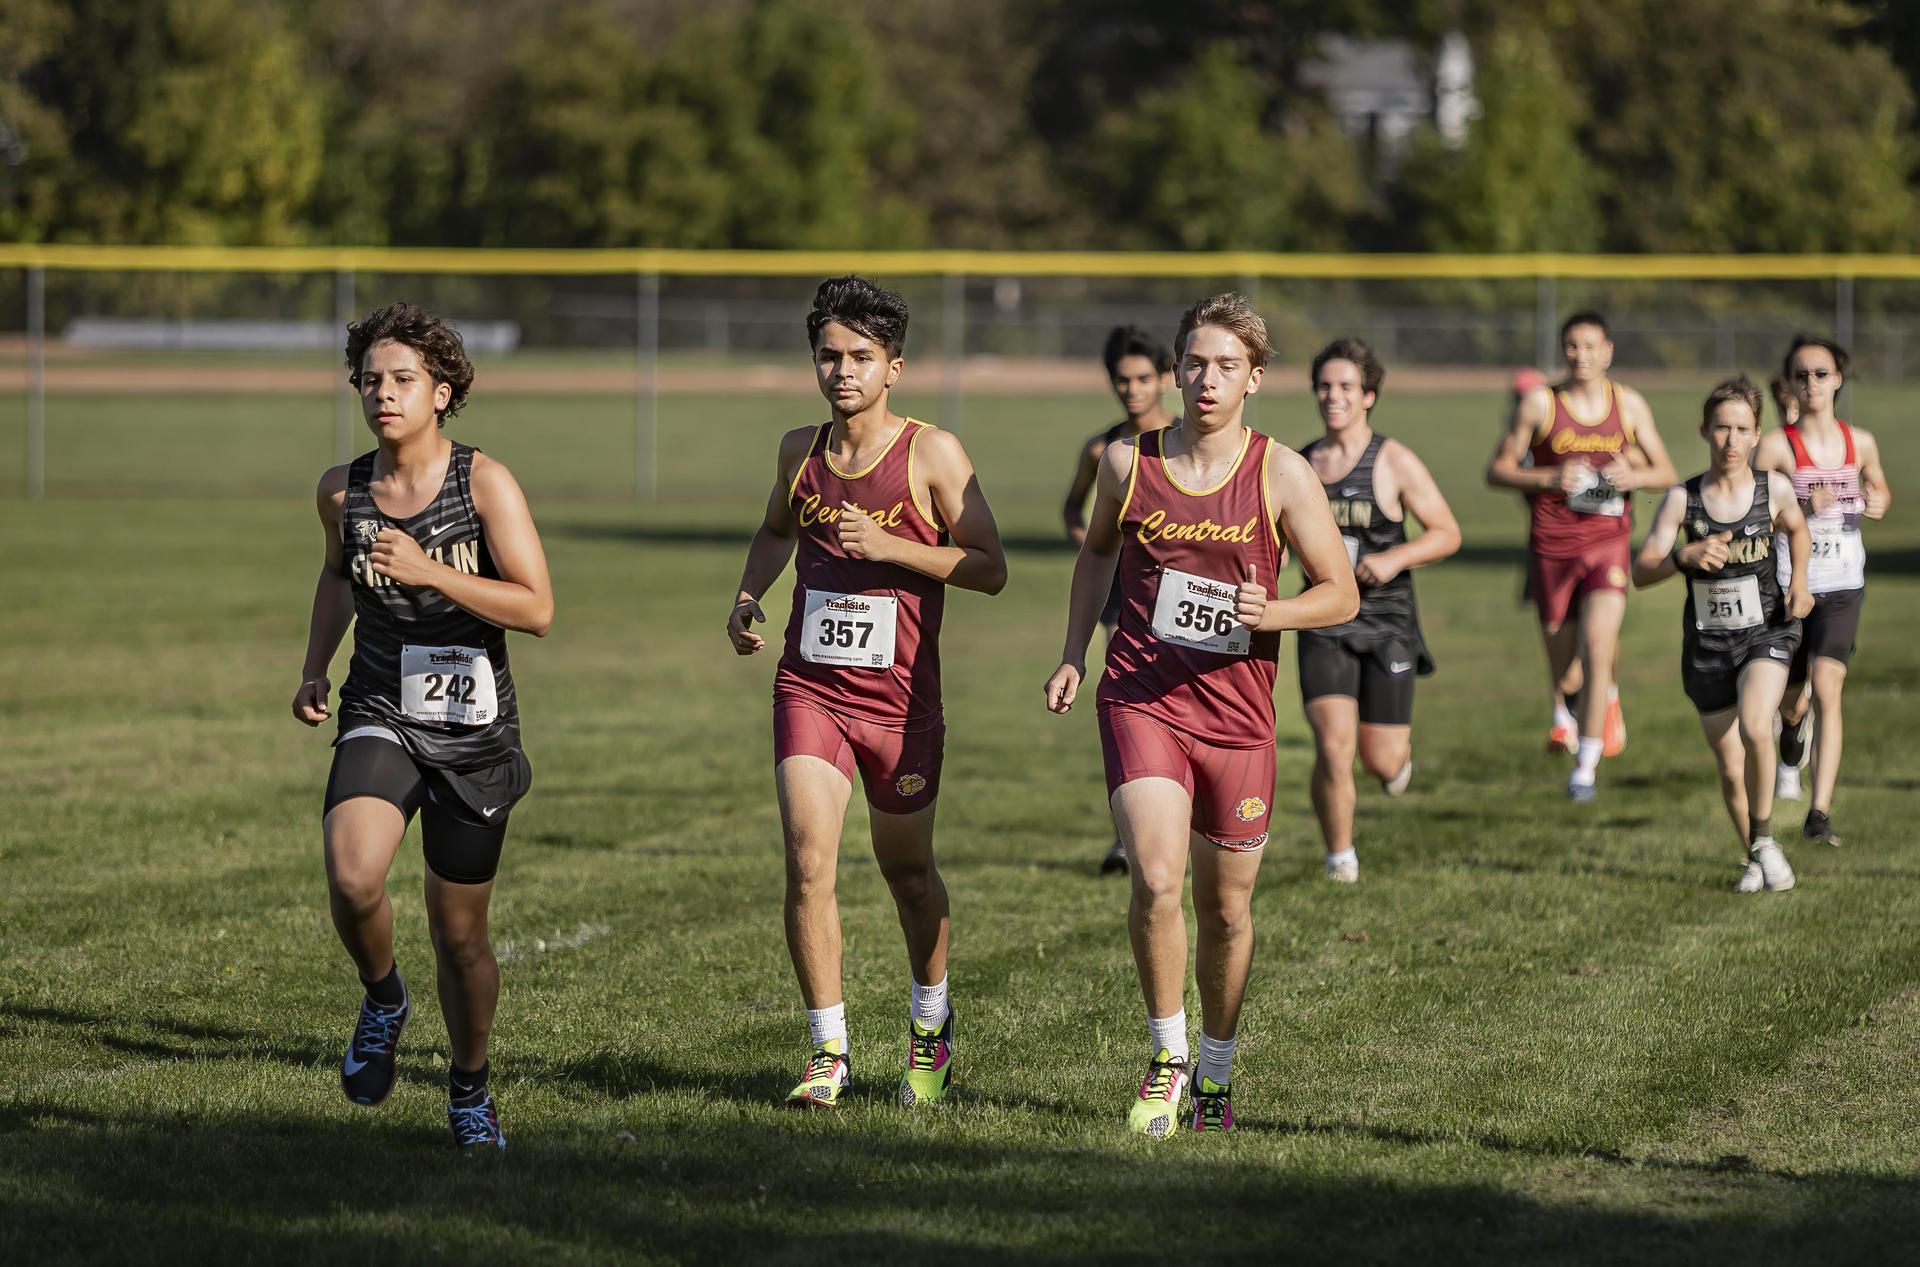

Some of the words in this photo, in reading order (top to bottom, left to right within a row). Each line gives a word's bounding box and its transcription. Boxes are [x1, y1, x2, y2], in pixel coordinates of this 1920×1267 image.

[1136, 509, 1258, 544] Central
[1174, 600, 1234, 637] 356
[1707, 599, 1744, 619] 251
[818, 618, 874, 649] 357
[424, 673, 477, 706] 242
